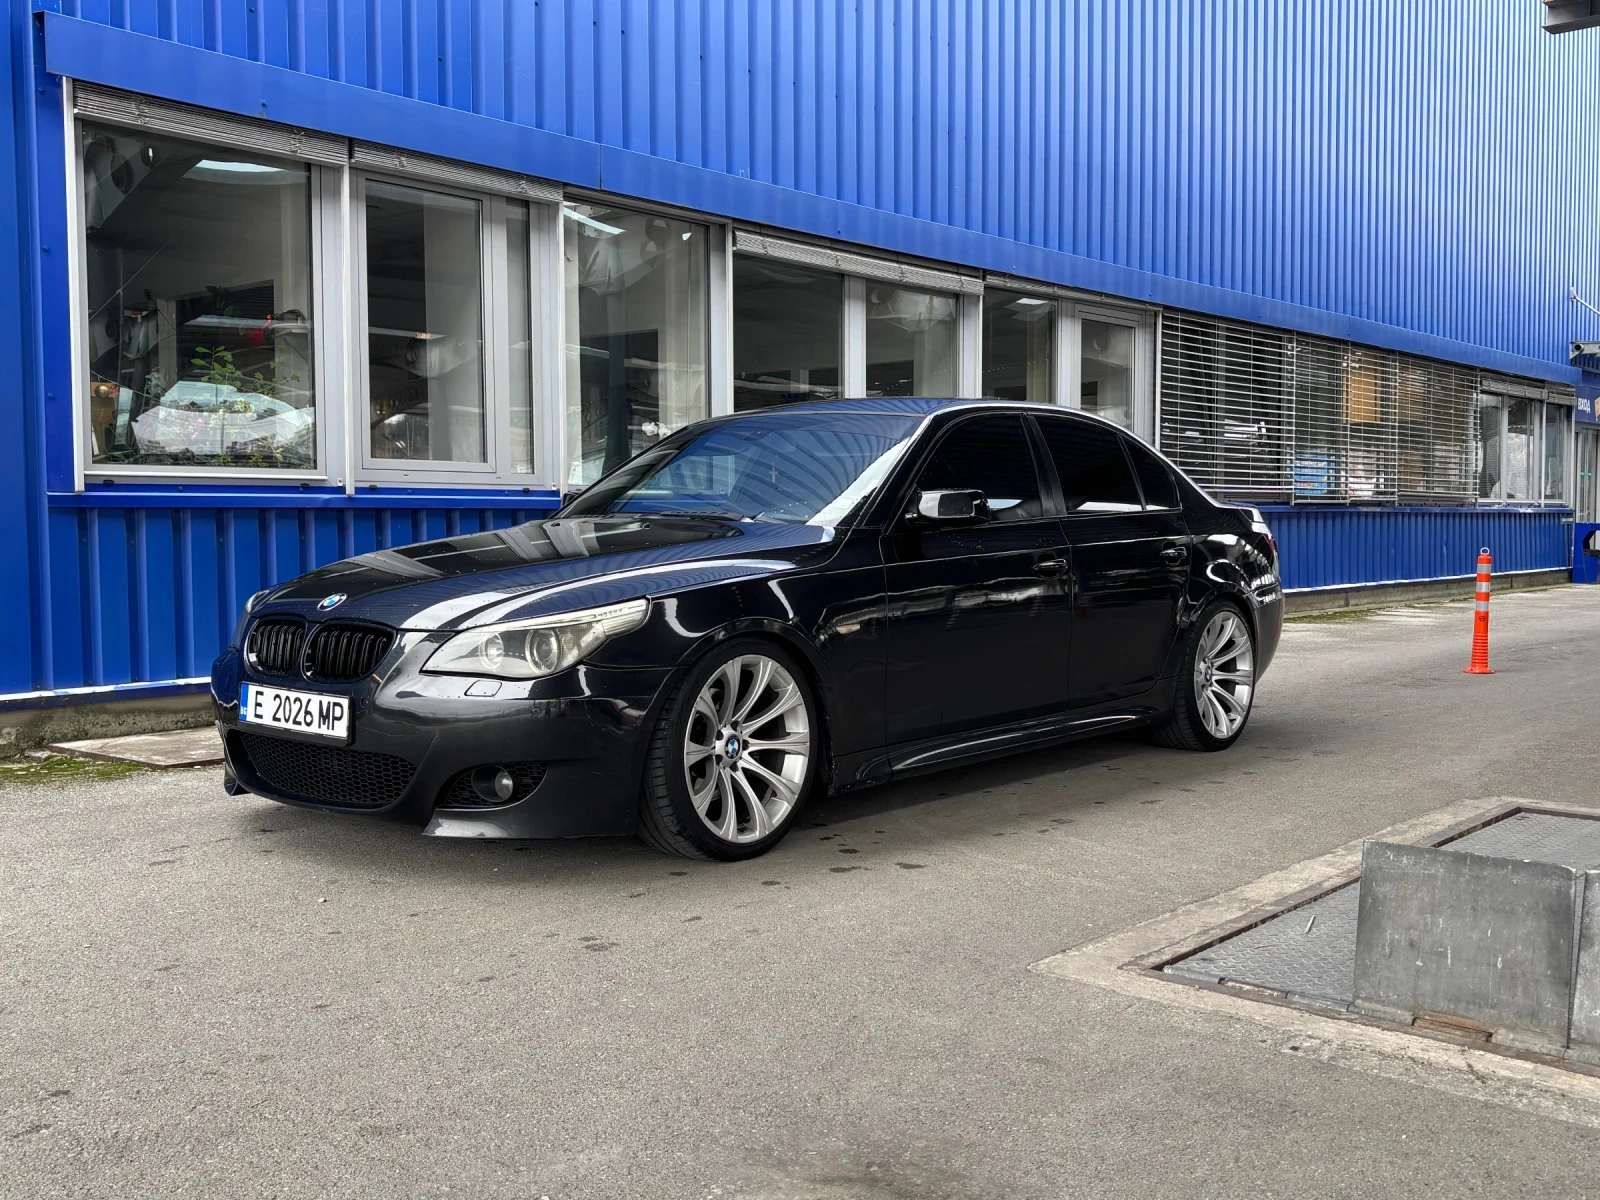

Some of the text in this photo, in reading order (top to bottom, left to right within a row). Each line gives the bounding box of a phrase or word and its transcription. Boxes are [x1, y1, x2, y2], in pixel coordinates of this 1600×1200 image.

[254, 690, 344, 730] E 2026 MP
